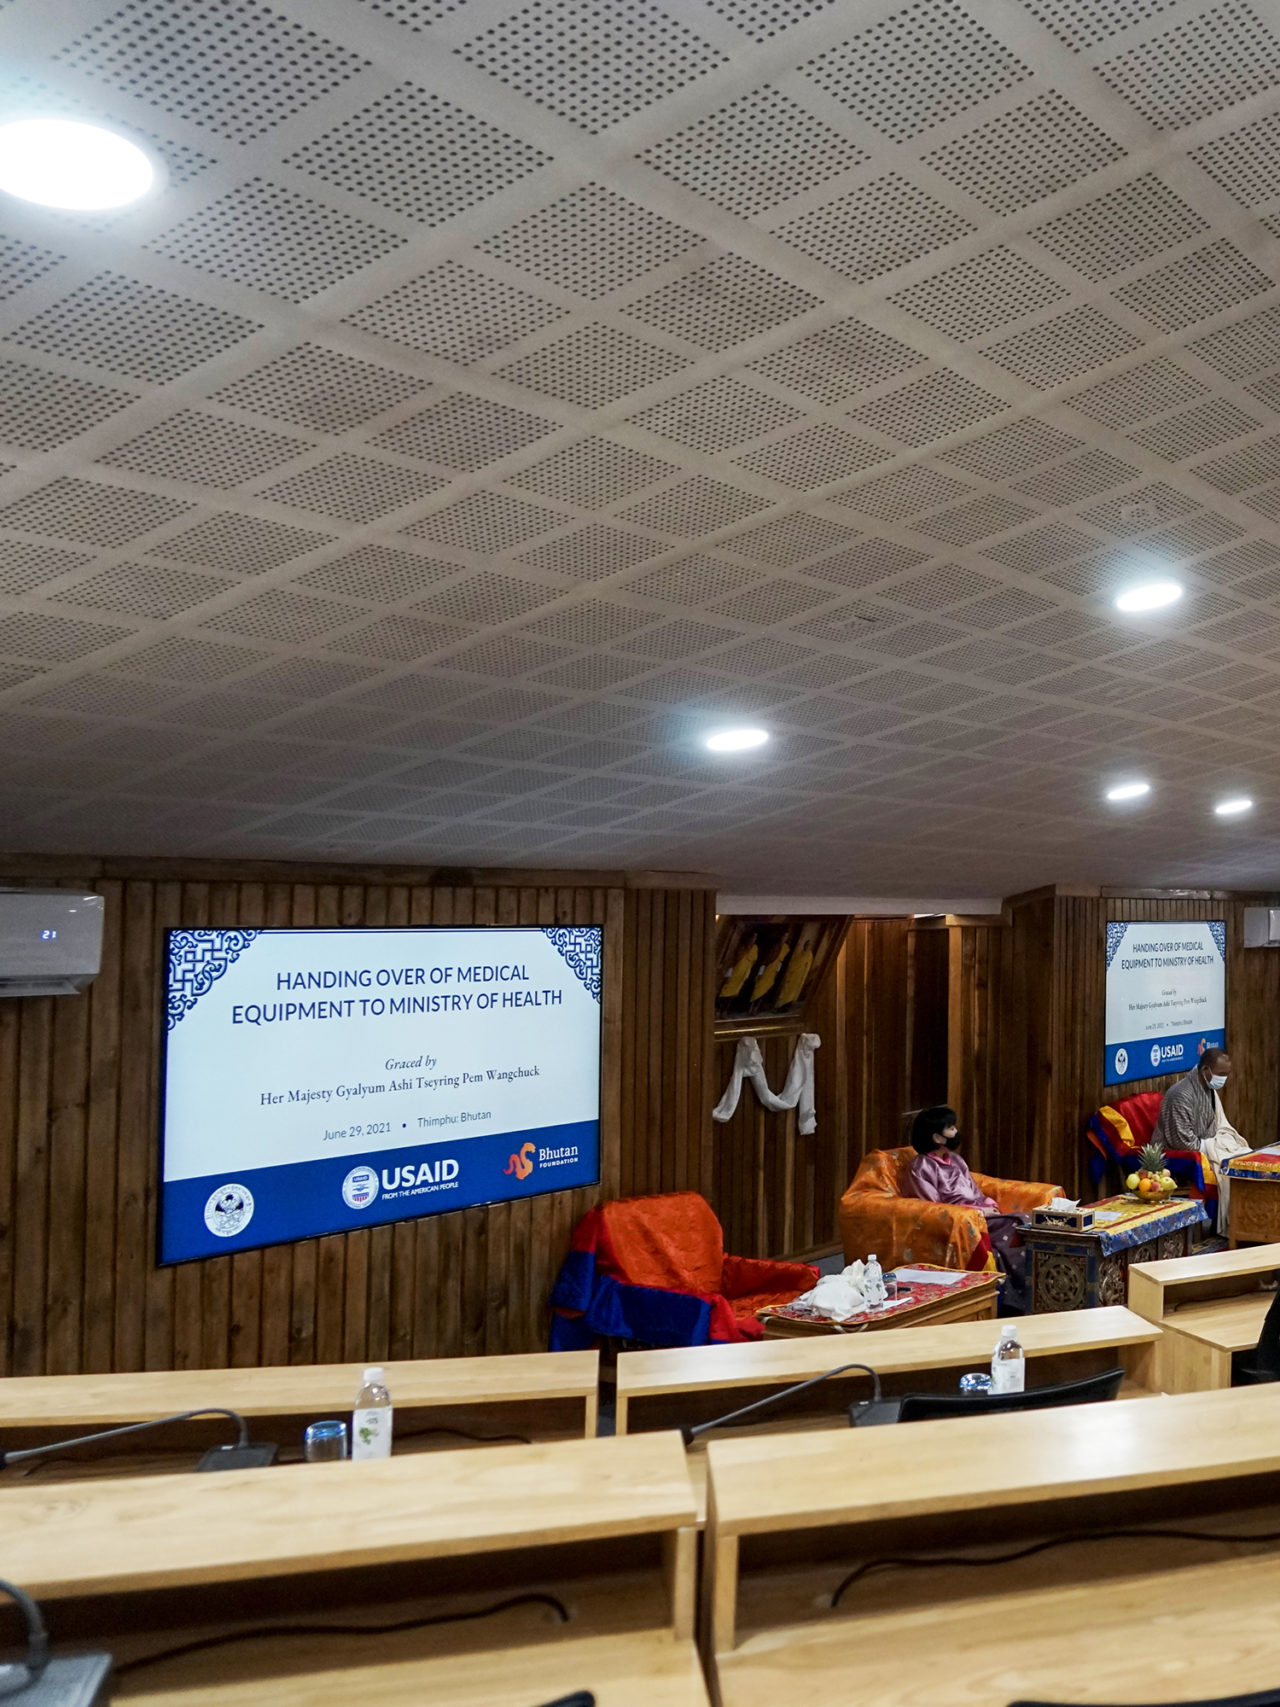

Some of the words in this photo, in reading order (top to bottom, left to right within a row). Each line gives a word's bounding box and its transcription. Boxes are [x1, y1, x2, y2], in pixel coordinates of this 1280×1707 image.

[42, 930, 56, 939] 21
[1132, 942, 1158, 953] HANDING
[1159, 942, 1174, 952] OVER
[1174, 942, 1181, 951] OF
[1181, 941, 1204, 951] MEDICAL
[1121, 957, 1154, 970] EQUIPMENT
[1155, 957, 1162, 967] TO
[1163, 956, 1187, 967] MINISTRY
[1187, 956, 1194, 965] OF
[1195, 955, 1214, 965] HEALTH
[276, 970, 372, 990] HANDING
[376, 968, 426, 987] OVER
[429, 967, 453, 984] OF
[457, 965, 530, 983] MEDICAL
[232, 1000, 355, 1026] EQUIPMENT
[359, 998, 385, 1016] TO
[389, 994, 473, 1015] MINISTRY
[476, 992, 498, 1009] OF
[502, 989, 562, 1008] HEALTH
[1161, 1044, 1184, 1058] USAID
[385, 1056, 423, 1070] Graced
[425, 1055, 437, 1071] by
[260, 1092, 284, 1105] Her
[288, 1089, 333, 1105] Majesty
[336, 1083, 386, 1101] Gyalyum
[388, 1078, 413, 1092] Ashi
[416, 1075, 460, 1091] Tseyring
[462, 1072, 483, 1084] Pem
[486, 1065, 540, 1083] Wangchuck
[322, 1129, 347, 1141] June
[367, 1122, 391, 1135] 2021
[461, 1110, 491, 1123] Bhutan
[539, 1146, 578, 1161] Bhutan
[540, 1158, 579, 1168] FOUNDATION
[382, 1159, 459, 1190] USAID
[382, 1191, 399, 1200] FROM
[399, 1189, 410, 1198] THE
[410, 1185, 438, 1196] AMERICAN
[440, 1181, 459, 1191] PEOPLE
